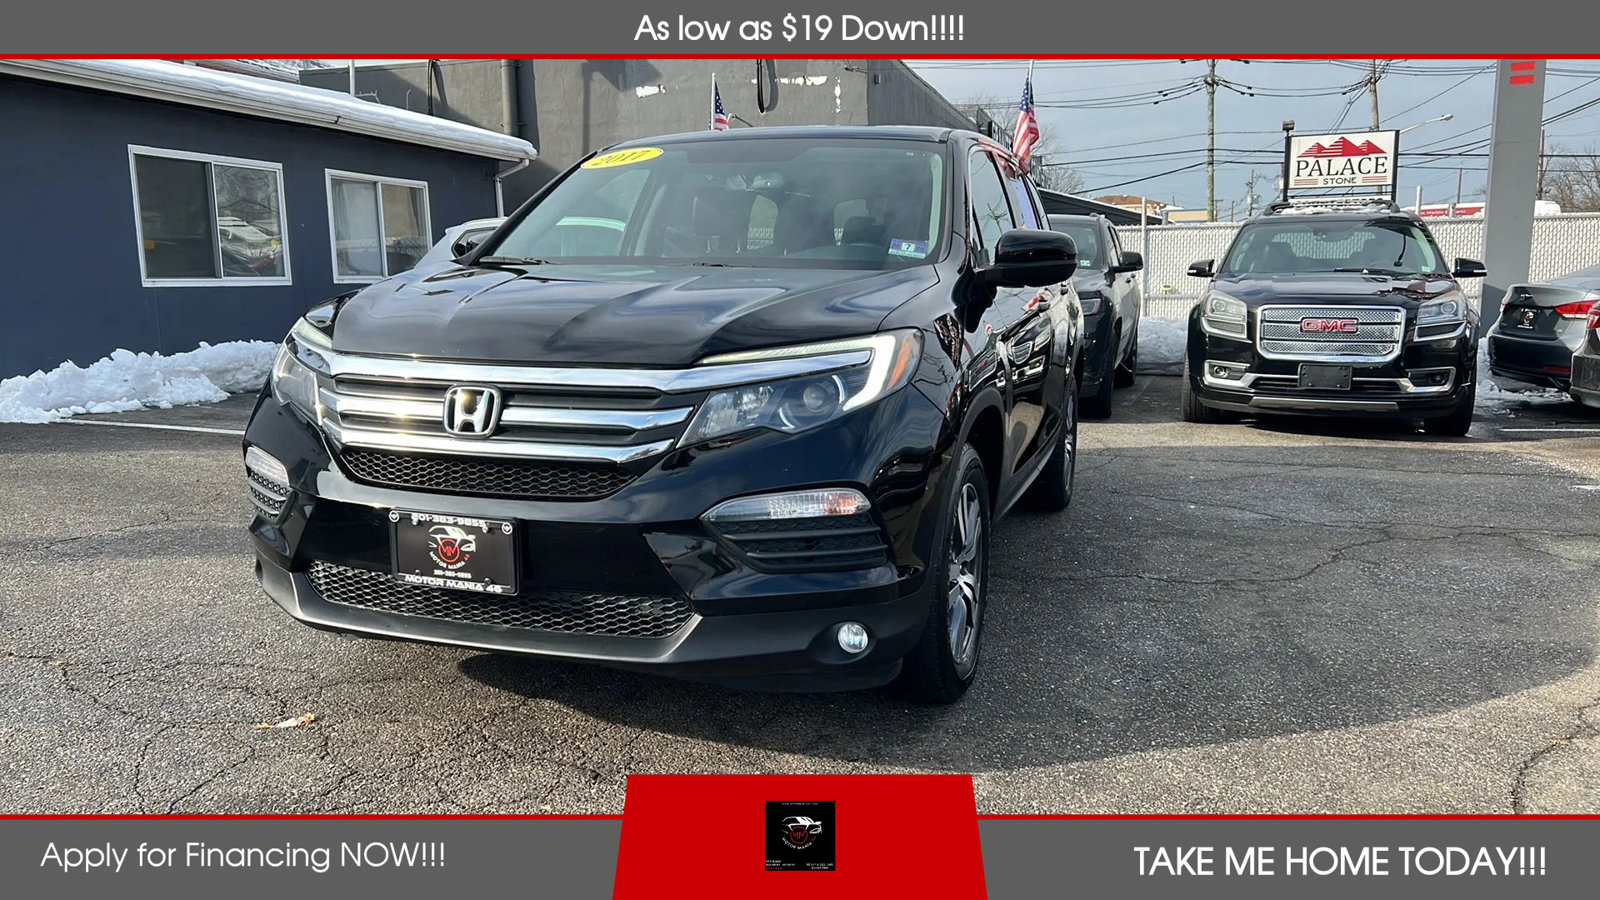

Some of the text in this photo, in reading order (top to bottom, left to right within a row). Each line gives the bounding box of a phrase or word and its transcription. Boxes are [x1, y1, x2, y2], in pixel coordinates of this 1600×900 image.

[591, 149, 652, 166] 2017
[1295, 156, 1388, 177] PALACE
[1323, 176, 1357, 185] STONE
[1301, 318, 1358, 332] GMC
[429, 551, 447, 568] MOTOR
[404, 574, 503, 593] MOTOR MANIA 46
